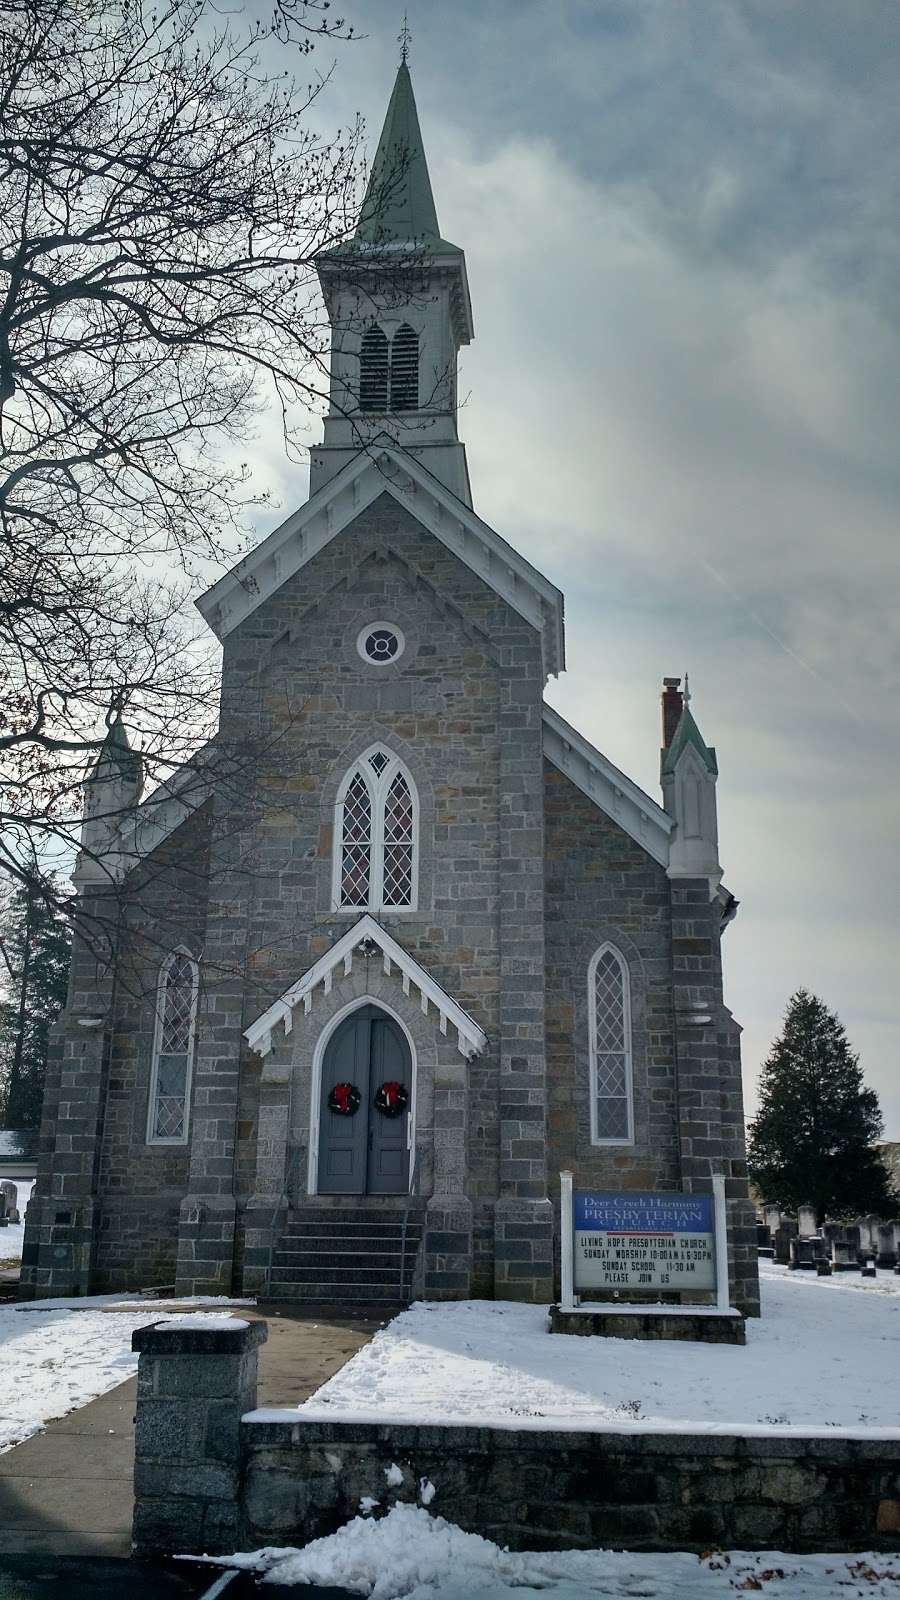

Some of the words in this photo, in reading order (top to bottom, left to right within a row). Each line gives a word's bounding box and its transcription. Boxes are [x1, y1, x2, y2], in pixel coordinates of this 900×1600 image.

[583, 1209, 702, 1220] PRESBYTERIAN
[580, 1237, 603, 1247] LIVING
[607, 1238, 625, 1248] HOPE
[628, 1238, 676, 1248] PRESBYTERIAN
[680, 1239, 707, 1249] CHURCH
[583, 1249, 609, 1259] SUNDAY
[615, 1249, 647, 1260] WORSHIP
[601, 1261, 627, 1271] SUNDAY
[631, 1261, 656, 1272] SCHOOL
[604, 1273, 629, 1283] PLEASE
[638, 1273, 652, 1283] JOIN
[660, 1274, 670, 1284] US
